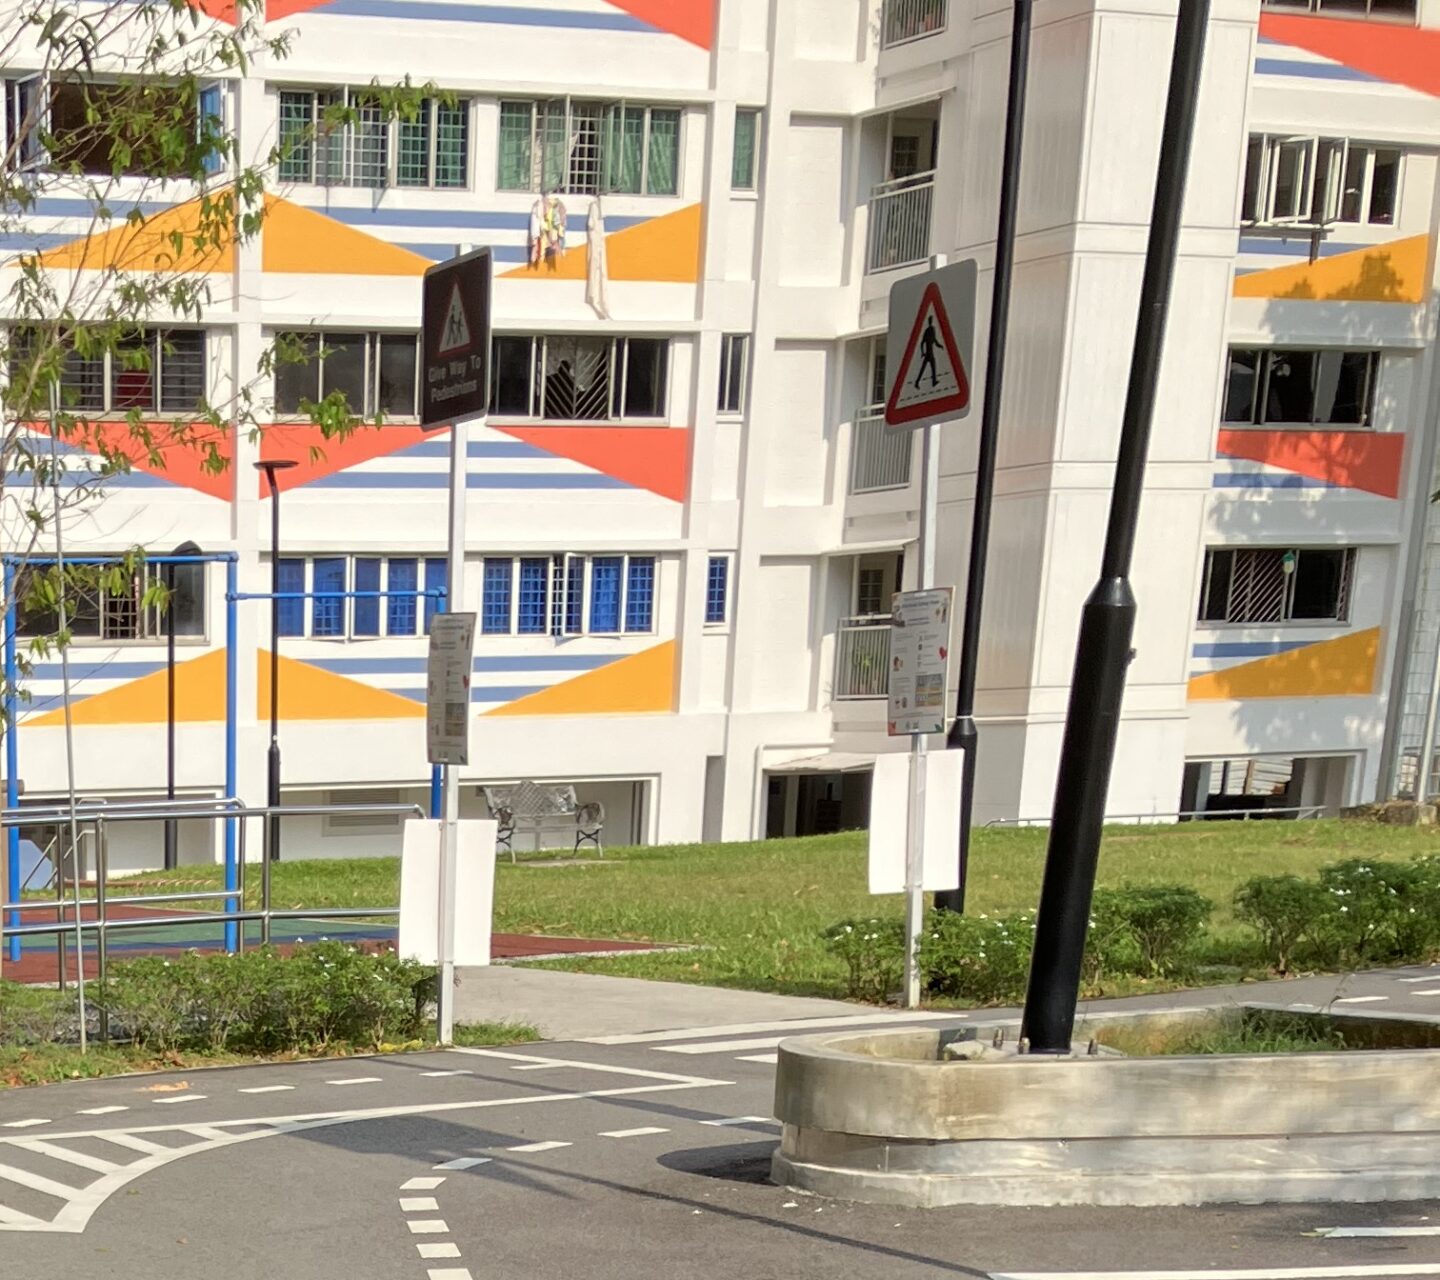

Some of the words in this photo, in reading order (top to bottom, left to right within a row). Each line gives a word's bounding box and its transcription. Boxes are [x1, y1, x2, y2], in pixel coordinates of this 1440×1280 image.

[428, 367, 446, 382] Give
[449, 361, 467, 378] Way
[470, 355, 481, 369] To
[431, 380, 477, 403] Pedestrians
